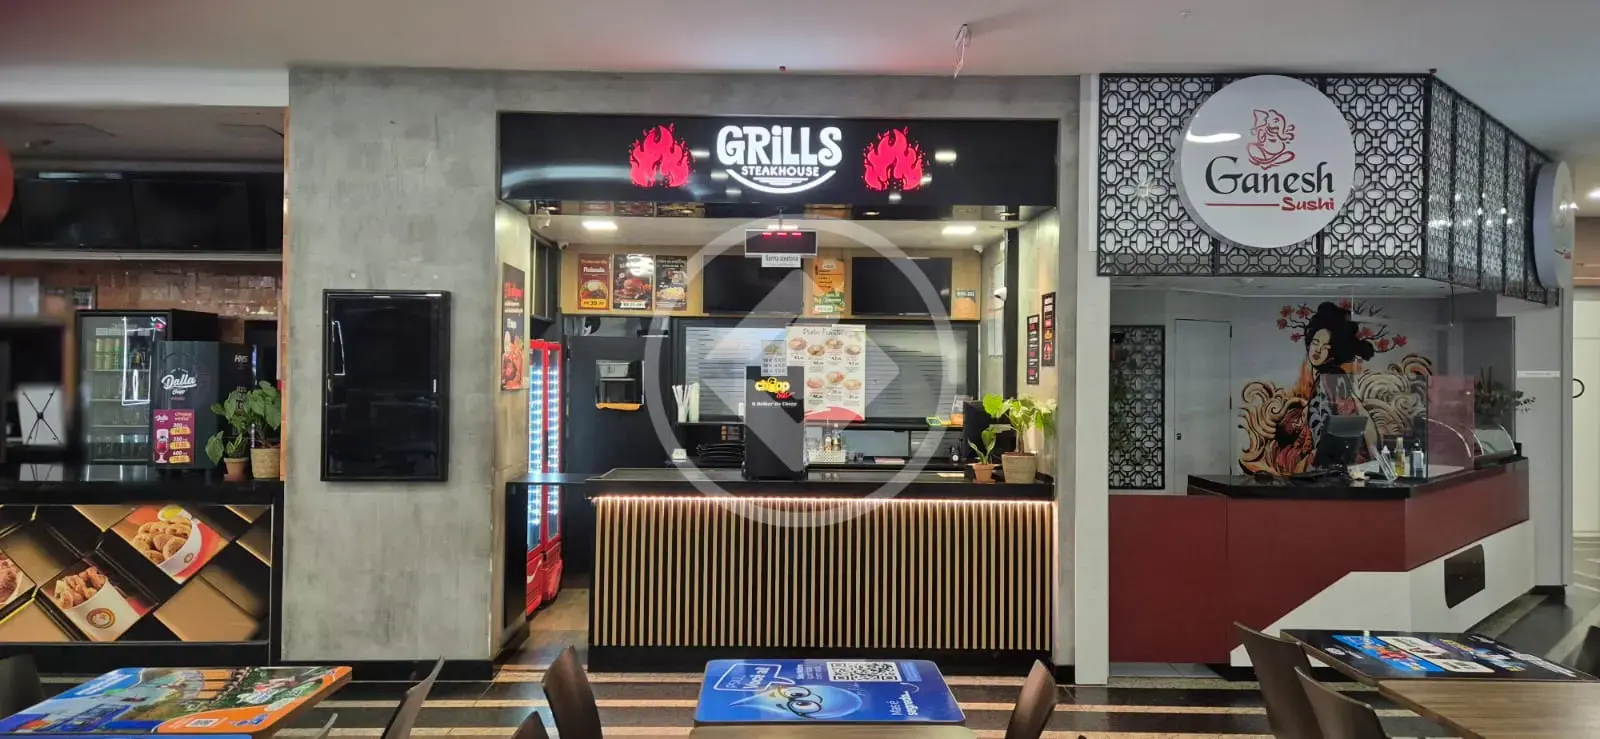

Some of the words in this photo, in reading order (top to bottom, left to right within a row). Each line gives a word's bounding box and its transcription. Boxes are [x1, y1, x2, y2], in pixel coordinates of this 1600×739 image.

[741, 166, 819, 177] STEAKHOUSE
[1205, 155, 1334, 195] Ganesh
[1281, 197, 1335, 211] Sushi
[161, 373, 197, 390] Dalla
